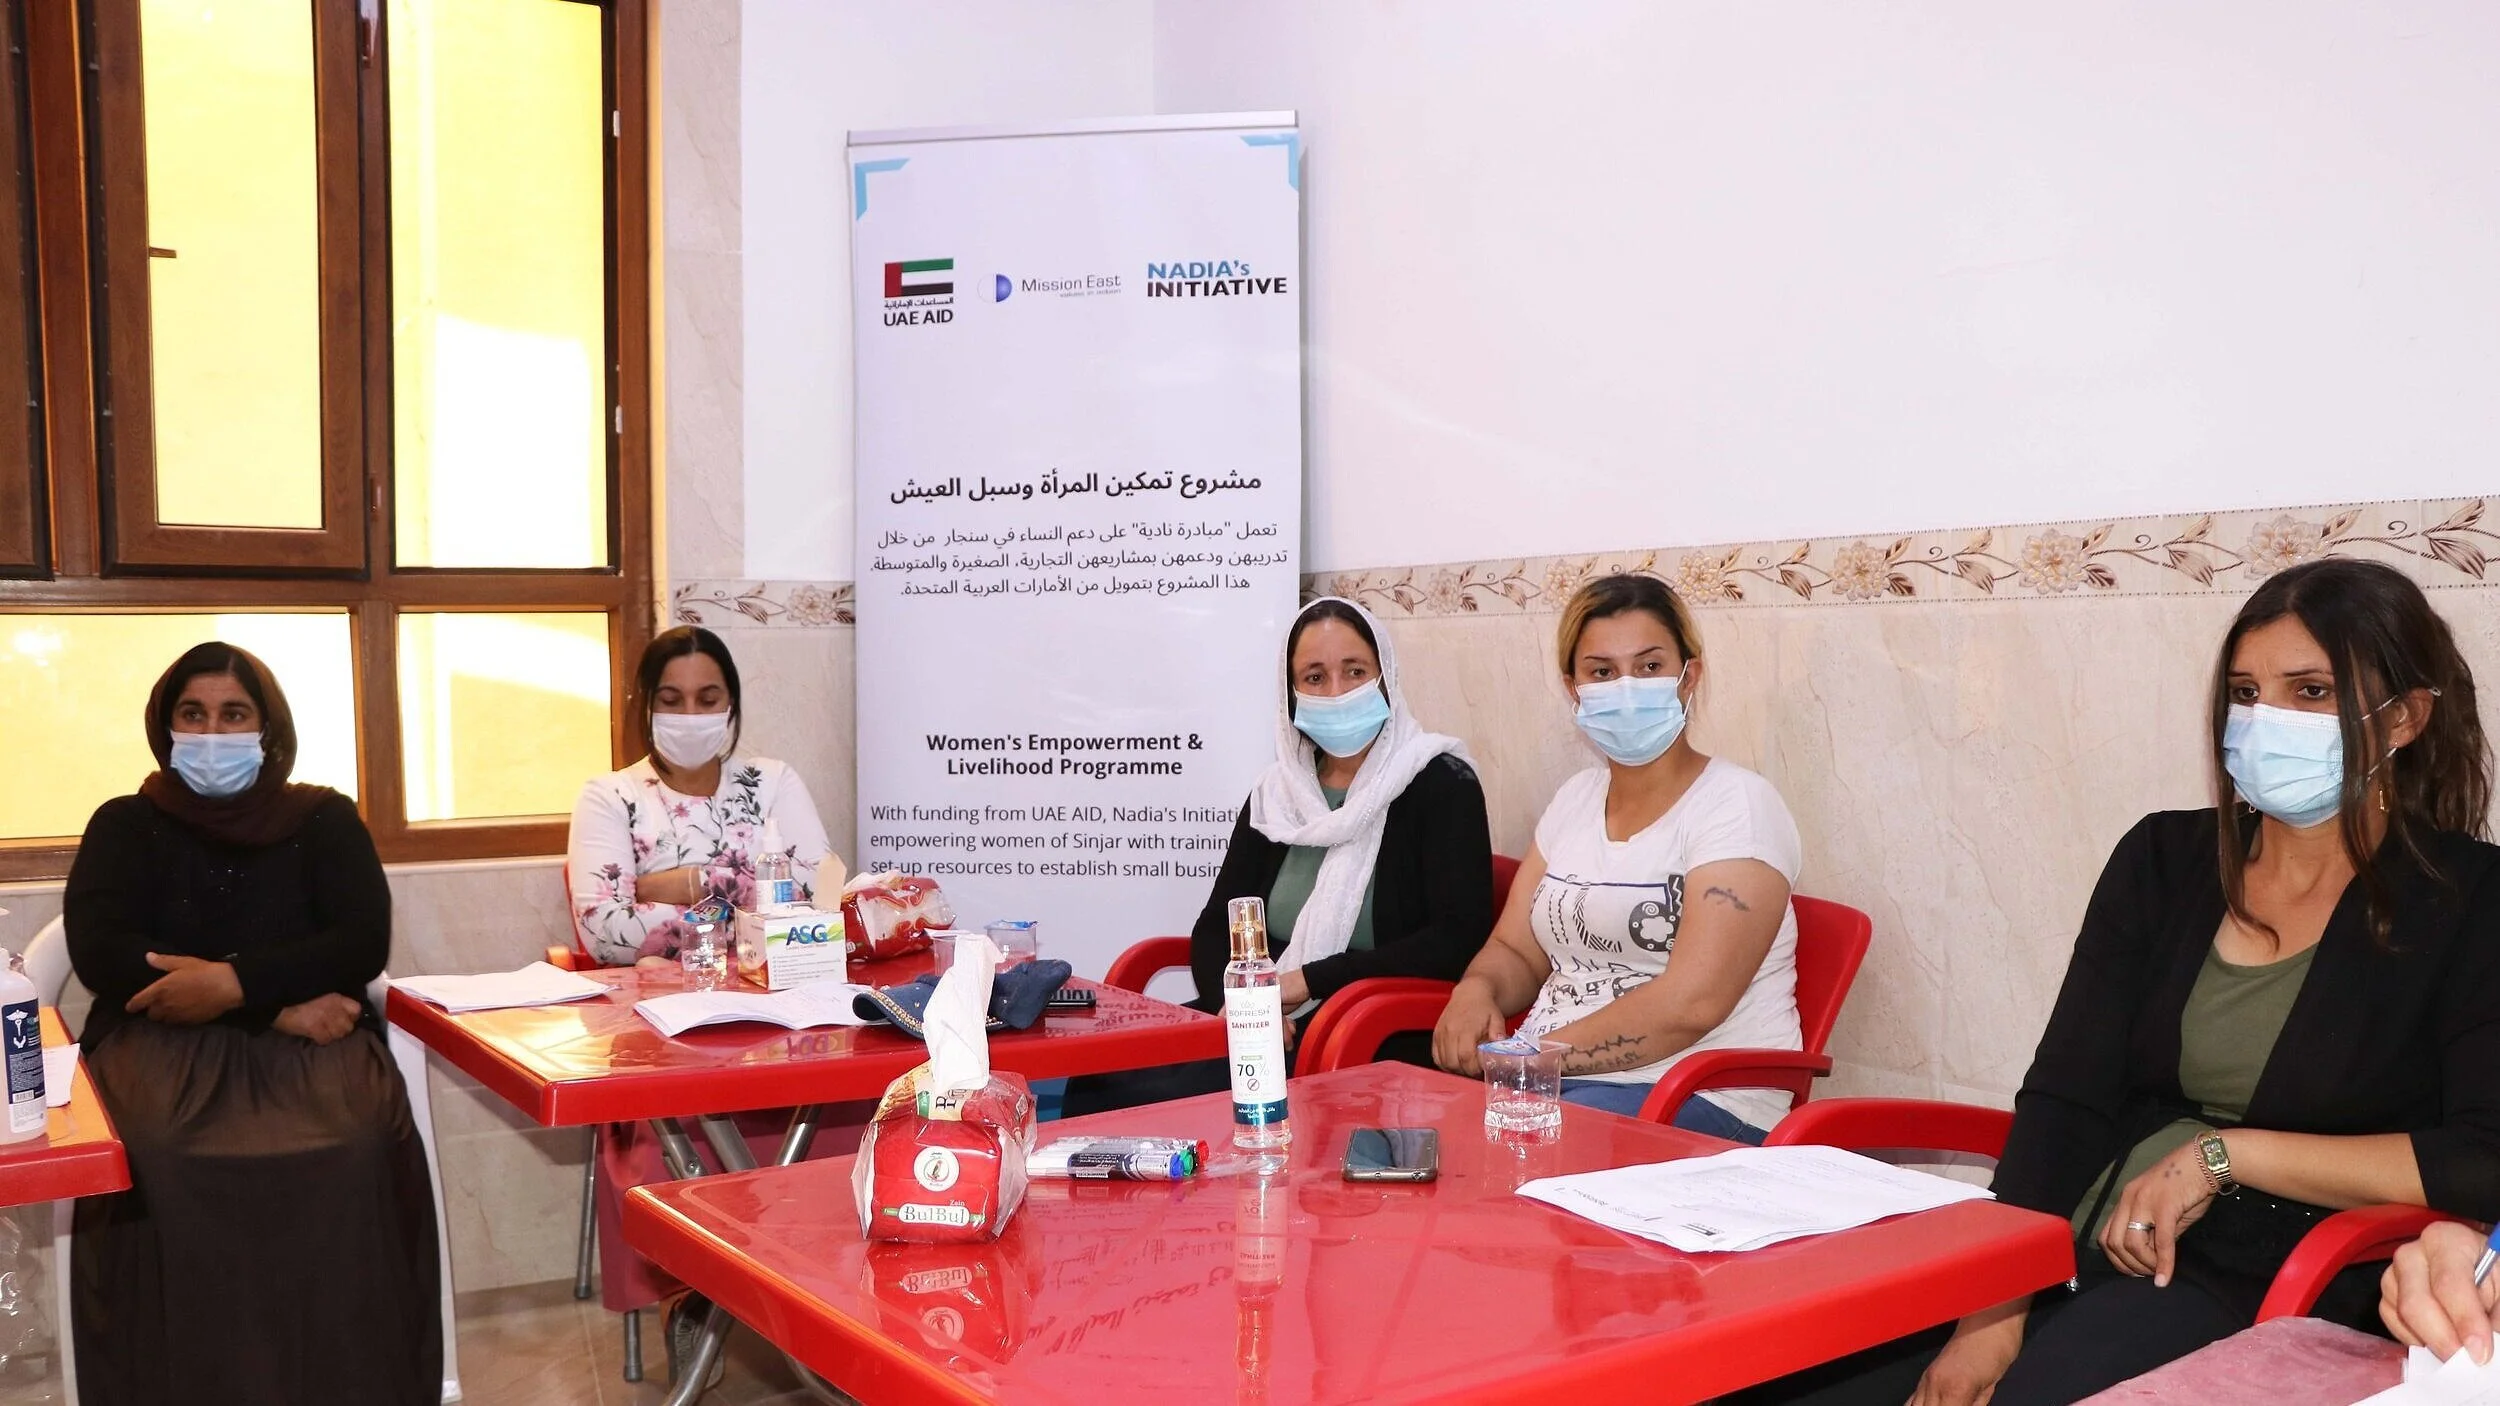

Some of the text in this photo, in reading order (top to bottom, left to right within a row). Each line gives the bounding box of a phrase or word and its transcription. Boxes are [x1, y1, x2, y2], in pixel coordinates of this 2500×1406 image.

[1022, 274, 1121, 292] Mission East
[1147, 277, 1287, 297] INITIATIVE
[884, 309, 954, 327] UAE AID
[890, 467, 1262, 504] مشروع تمكين المرأة وسبل العيش
[877, 521, 1278, 549] تعمل "مبادرة نادية" على دعم النساء في سنجار من خلال
[952, 553, 1009, 572] الصغيرة
[1077, 549, 1157, 569] بمشاريعهن
[1161, 551, 1223, 567] ودعمهن
[1228, 549, 1288, 567] تدريبهن
[900, 573, 1251, 597] هذا المشروع بتمويل من الأمارات العربية المتحدة.
[926, 733, 1203, 755] Women's Empowerment &
[947, 757, 1183, 780] Livelihood Programme
[870, 805, 1240, 825] With funding from UAE AID, Nadia's Initiati
[870, 832, 1229, 853] empowering women of Sinjar with trainin
[871, 859, 1223, 877] set-up resources to establish small busin
[786, 923, 829, 945] ASG
[1231, 1020, 1270, 1030] SANITIZER
[1237, 1063, 1255, 1077] 70
[903, 1206, 965, 1224] BulBul
